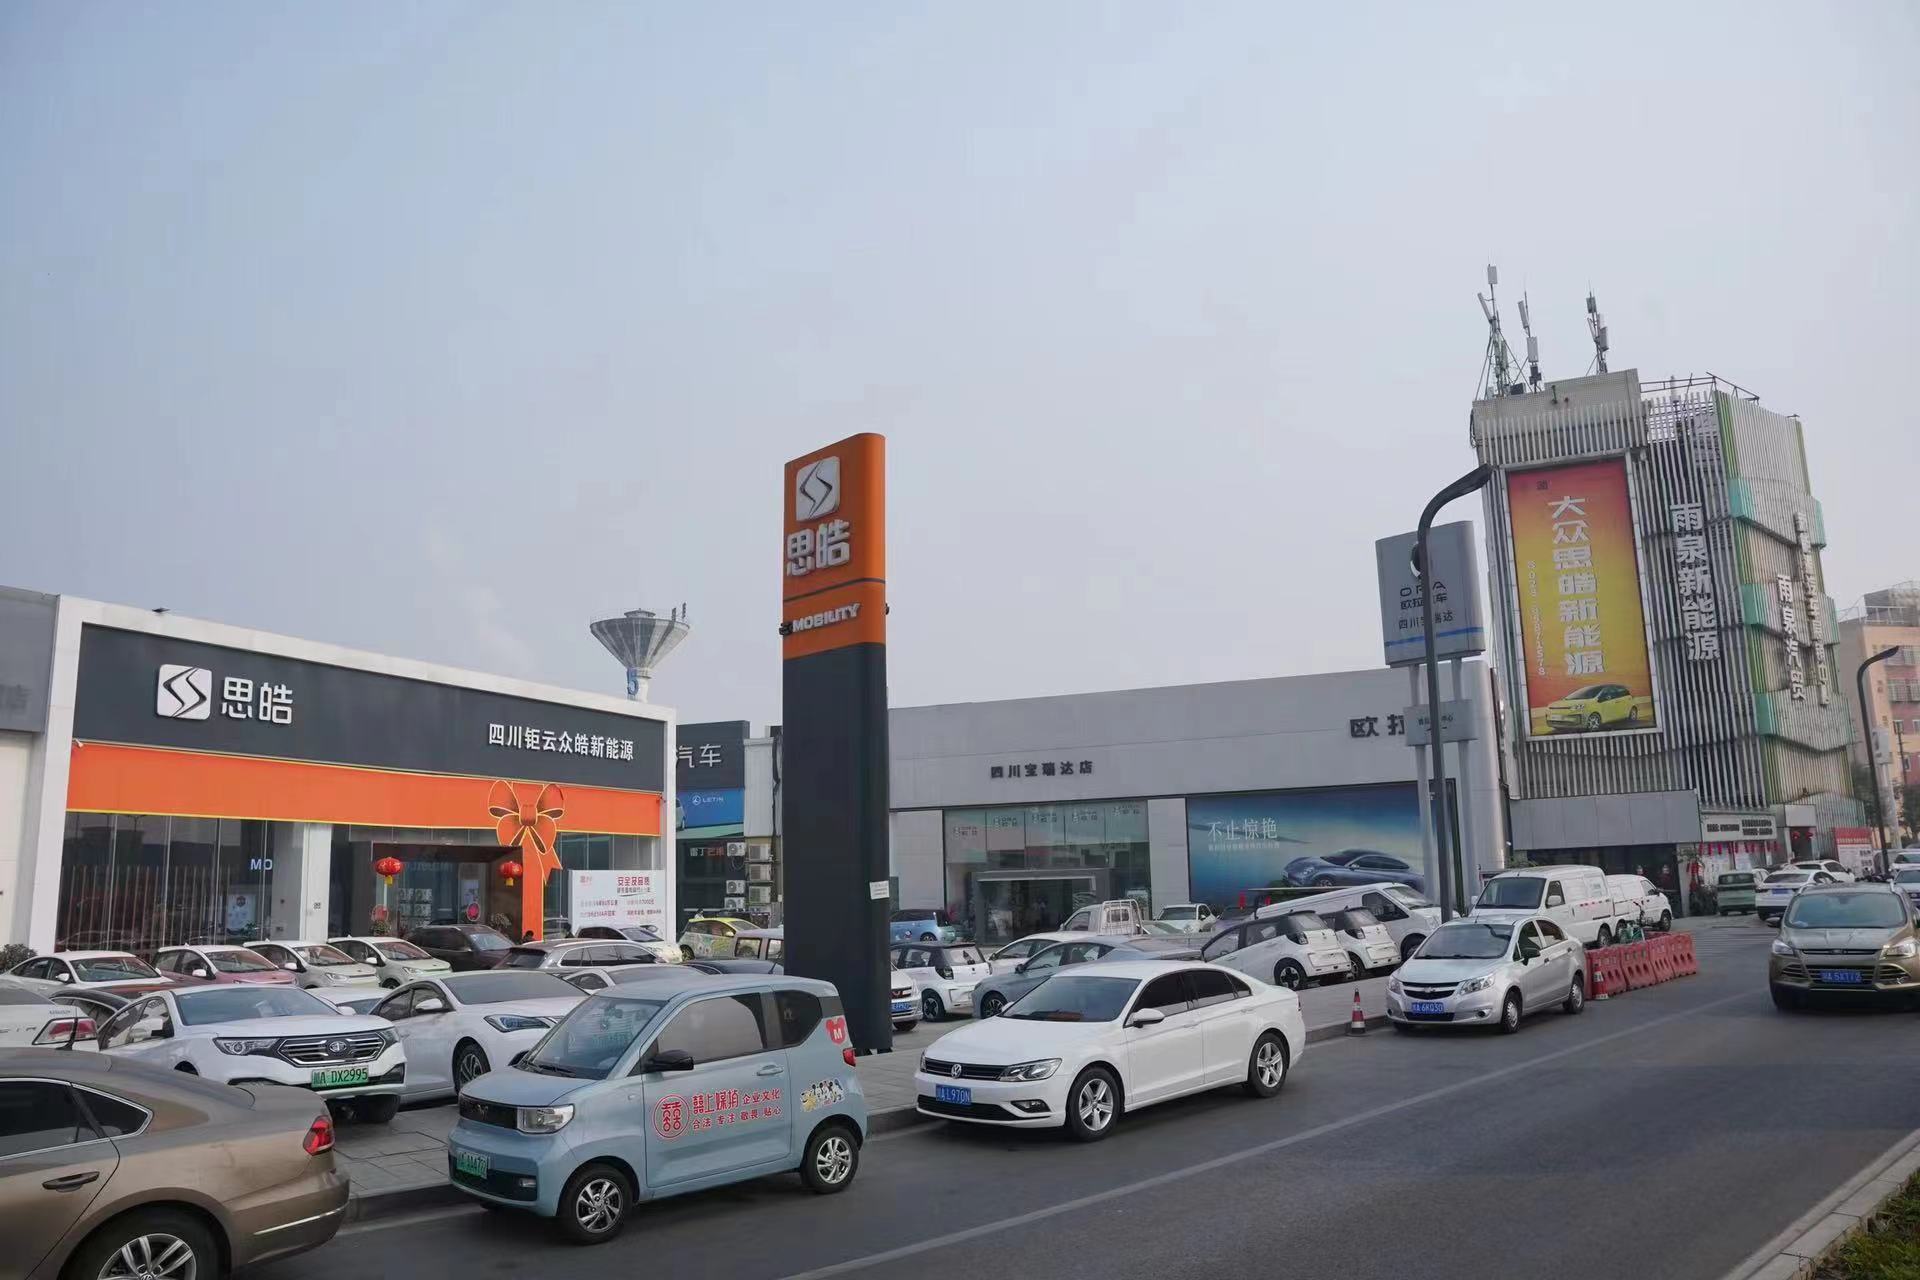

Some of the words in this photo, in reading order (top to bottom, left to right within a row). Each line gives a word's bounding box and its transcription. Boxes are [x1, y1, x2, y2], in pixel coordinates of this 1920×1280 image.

[787, 519, 850, 577] 思皓
[1670, 502, 1720, 661] 雨泉新能源
[1401, 592, 1448, 610] 欧拉车
[792, 603, 860, 631] MOBILITY
[221, 676, 293, 725] 思皓
[488, 722, 634, 761] 四川钜云众皓新能源
[990, 759, 1094, 779] 四川宝瑞达店
[1207, 817, 1278, 844] 不止惊艳
[742, 1089, 781, 1105] 企业文化
